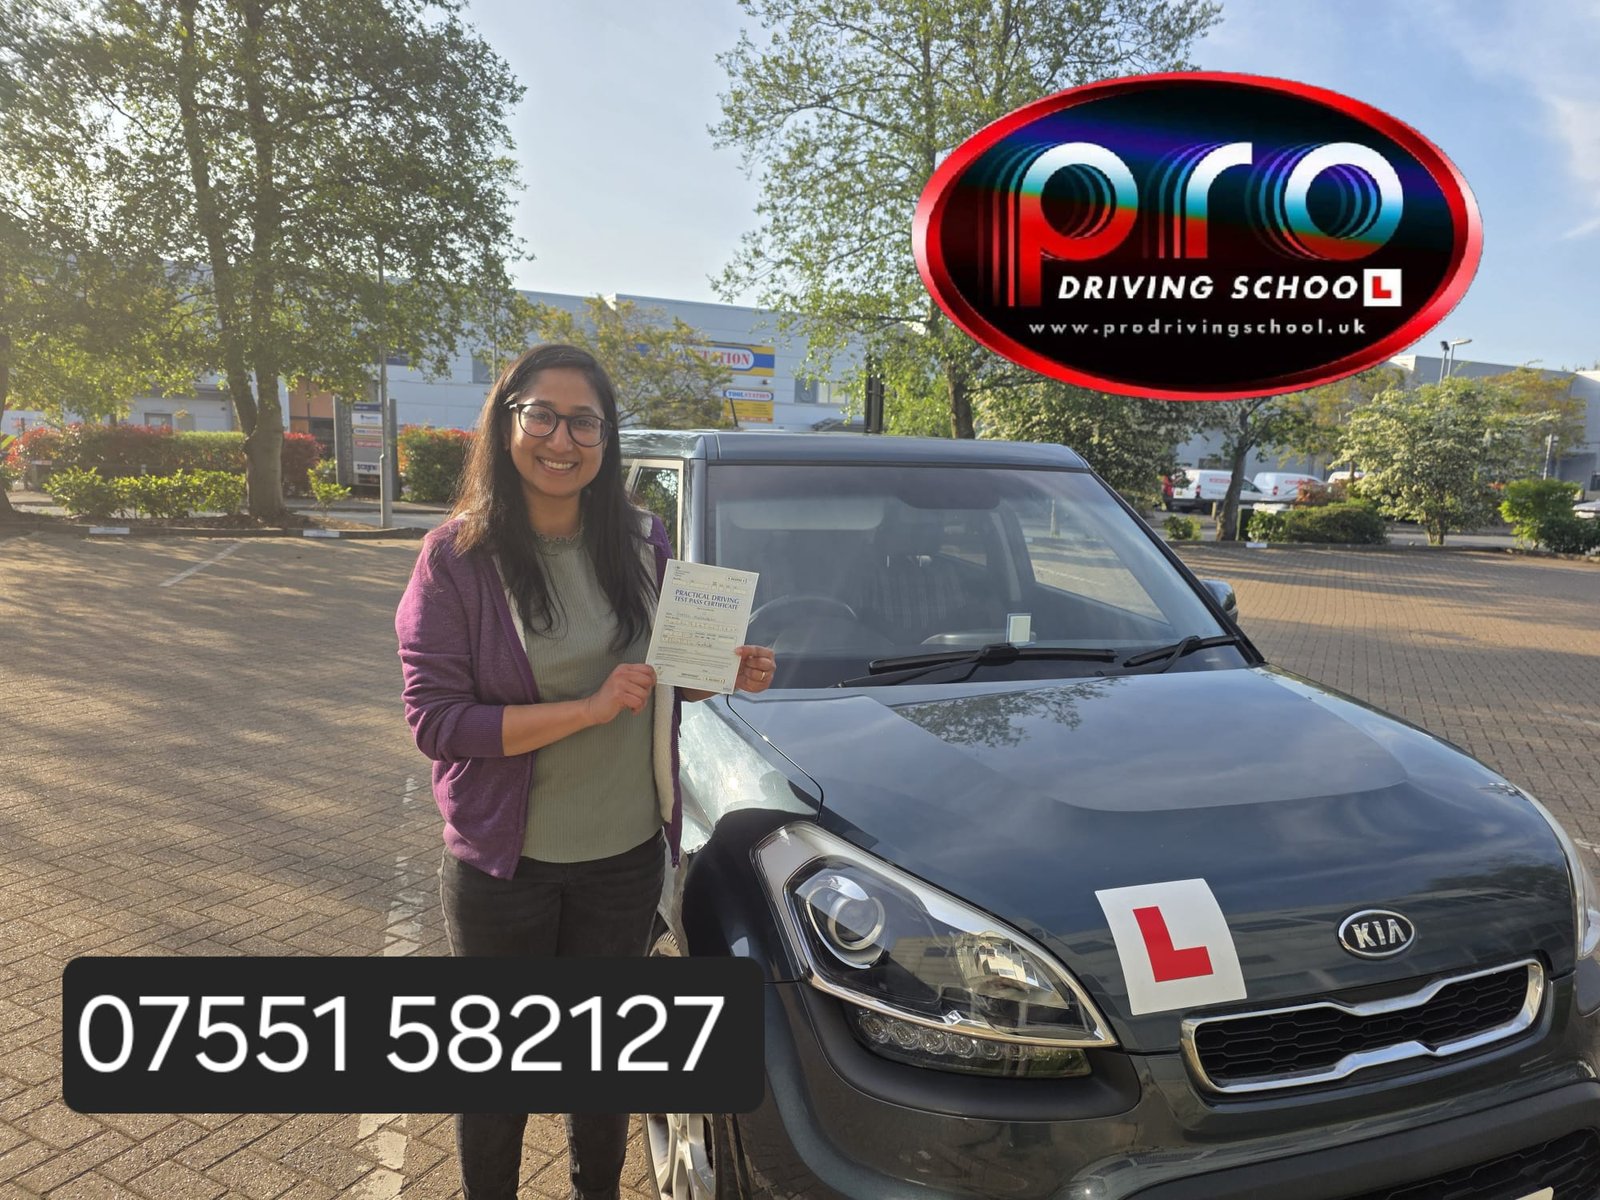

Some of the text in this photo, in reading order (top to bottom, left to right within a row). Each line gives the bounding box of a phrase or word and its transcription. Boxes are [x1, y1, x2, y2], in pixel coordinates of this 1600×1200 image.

[675, 589, 739, 604] PRACTICAL DRIVING
[688, 597, 703, 605] PASS
[704, 599, 738, 610] CERTIFICATE
[1132, 906, 1214, 983] L
[1353, 919, 1407, 948] KIA
